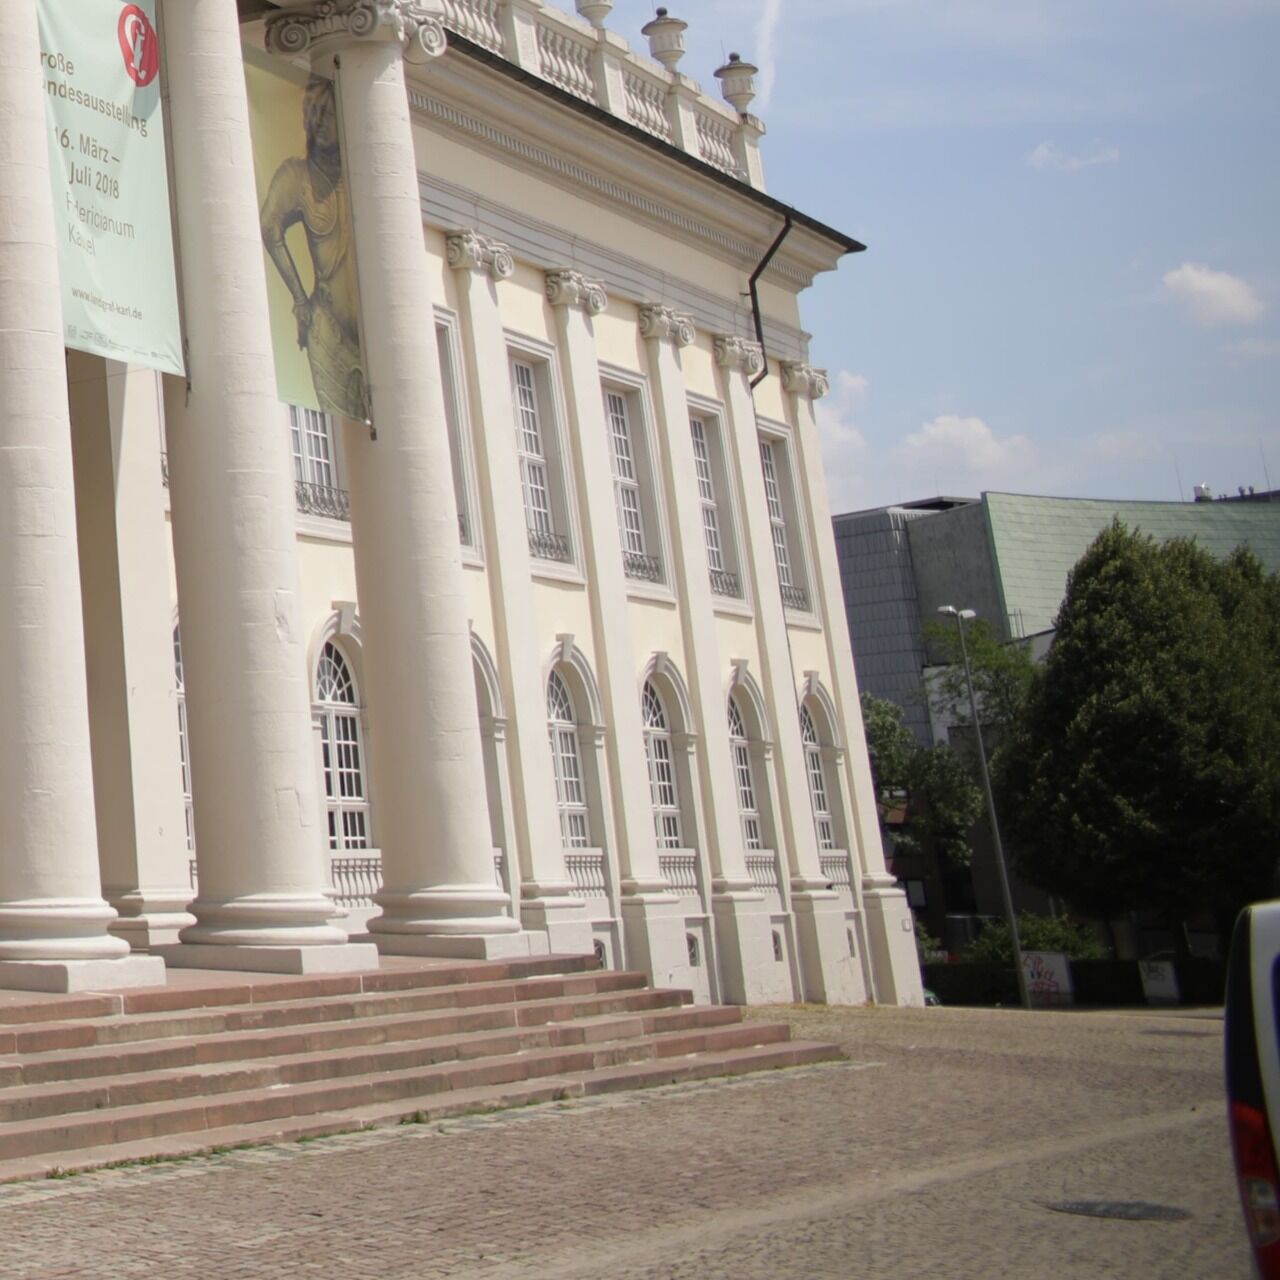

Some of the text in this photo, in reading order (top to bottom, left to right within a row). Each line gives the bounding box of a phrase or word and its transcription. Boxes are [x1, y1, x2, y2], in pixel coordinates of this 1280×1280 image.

[40, 51, 74, 75] roße
[80, 133, 108, 163] März
[69, 161, 119, 199] Juli 2018
